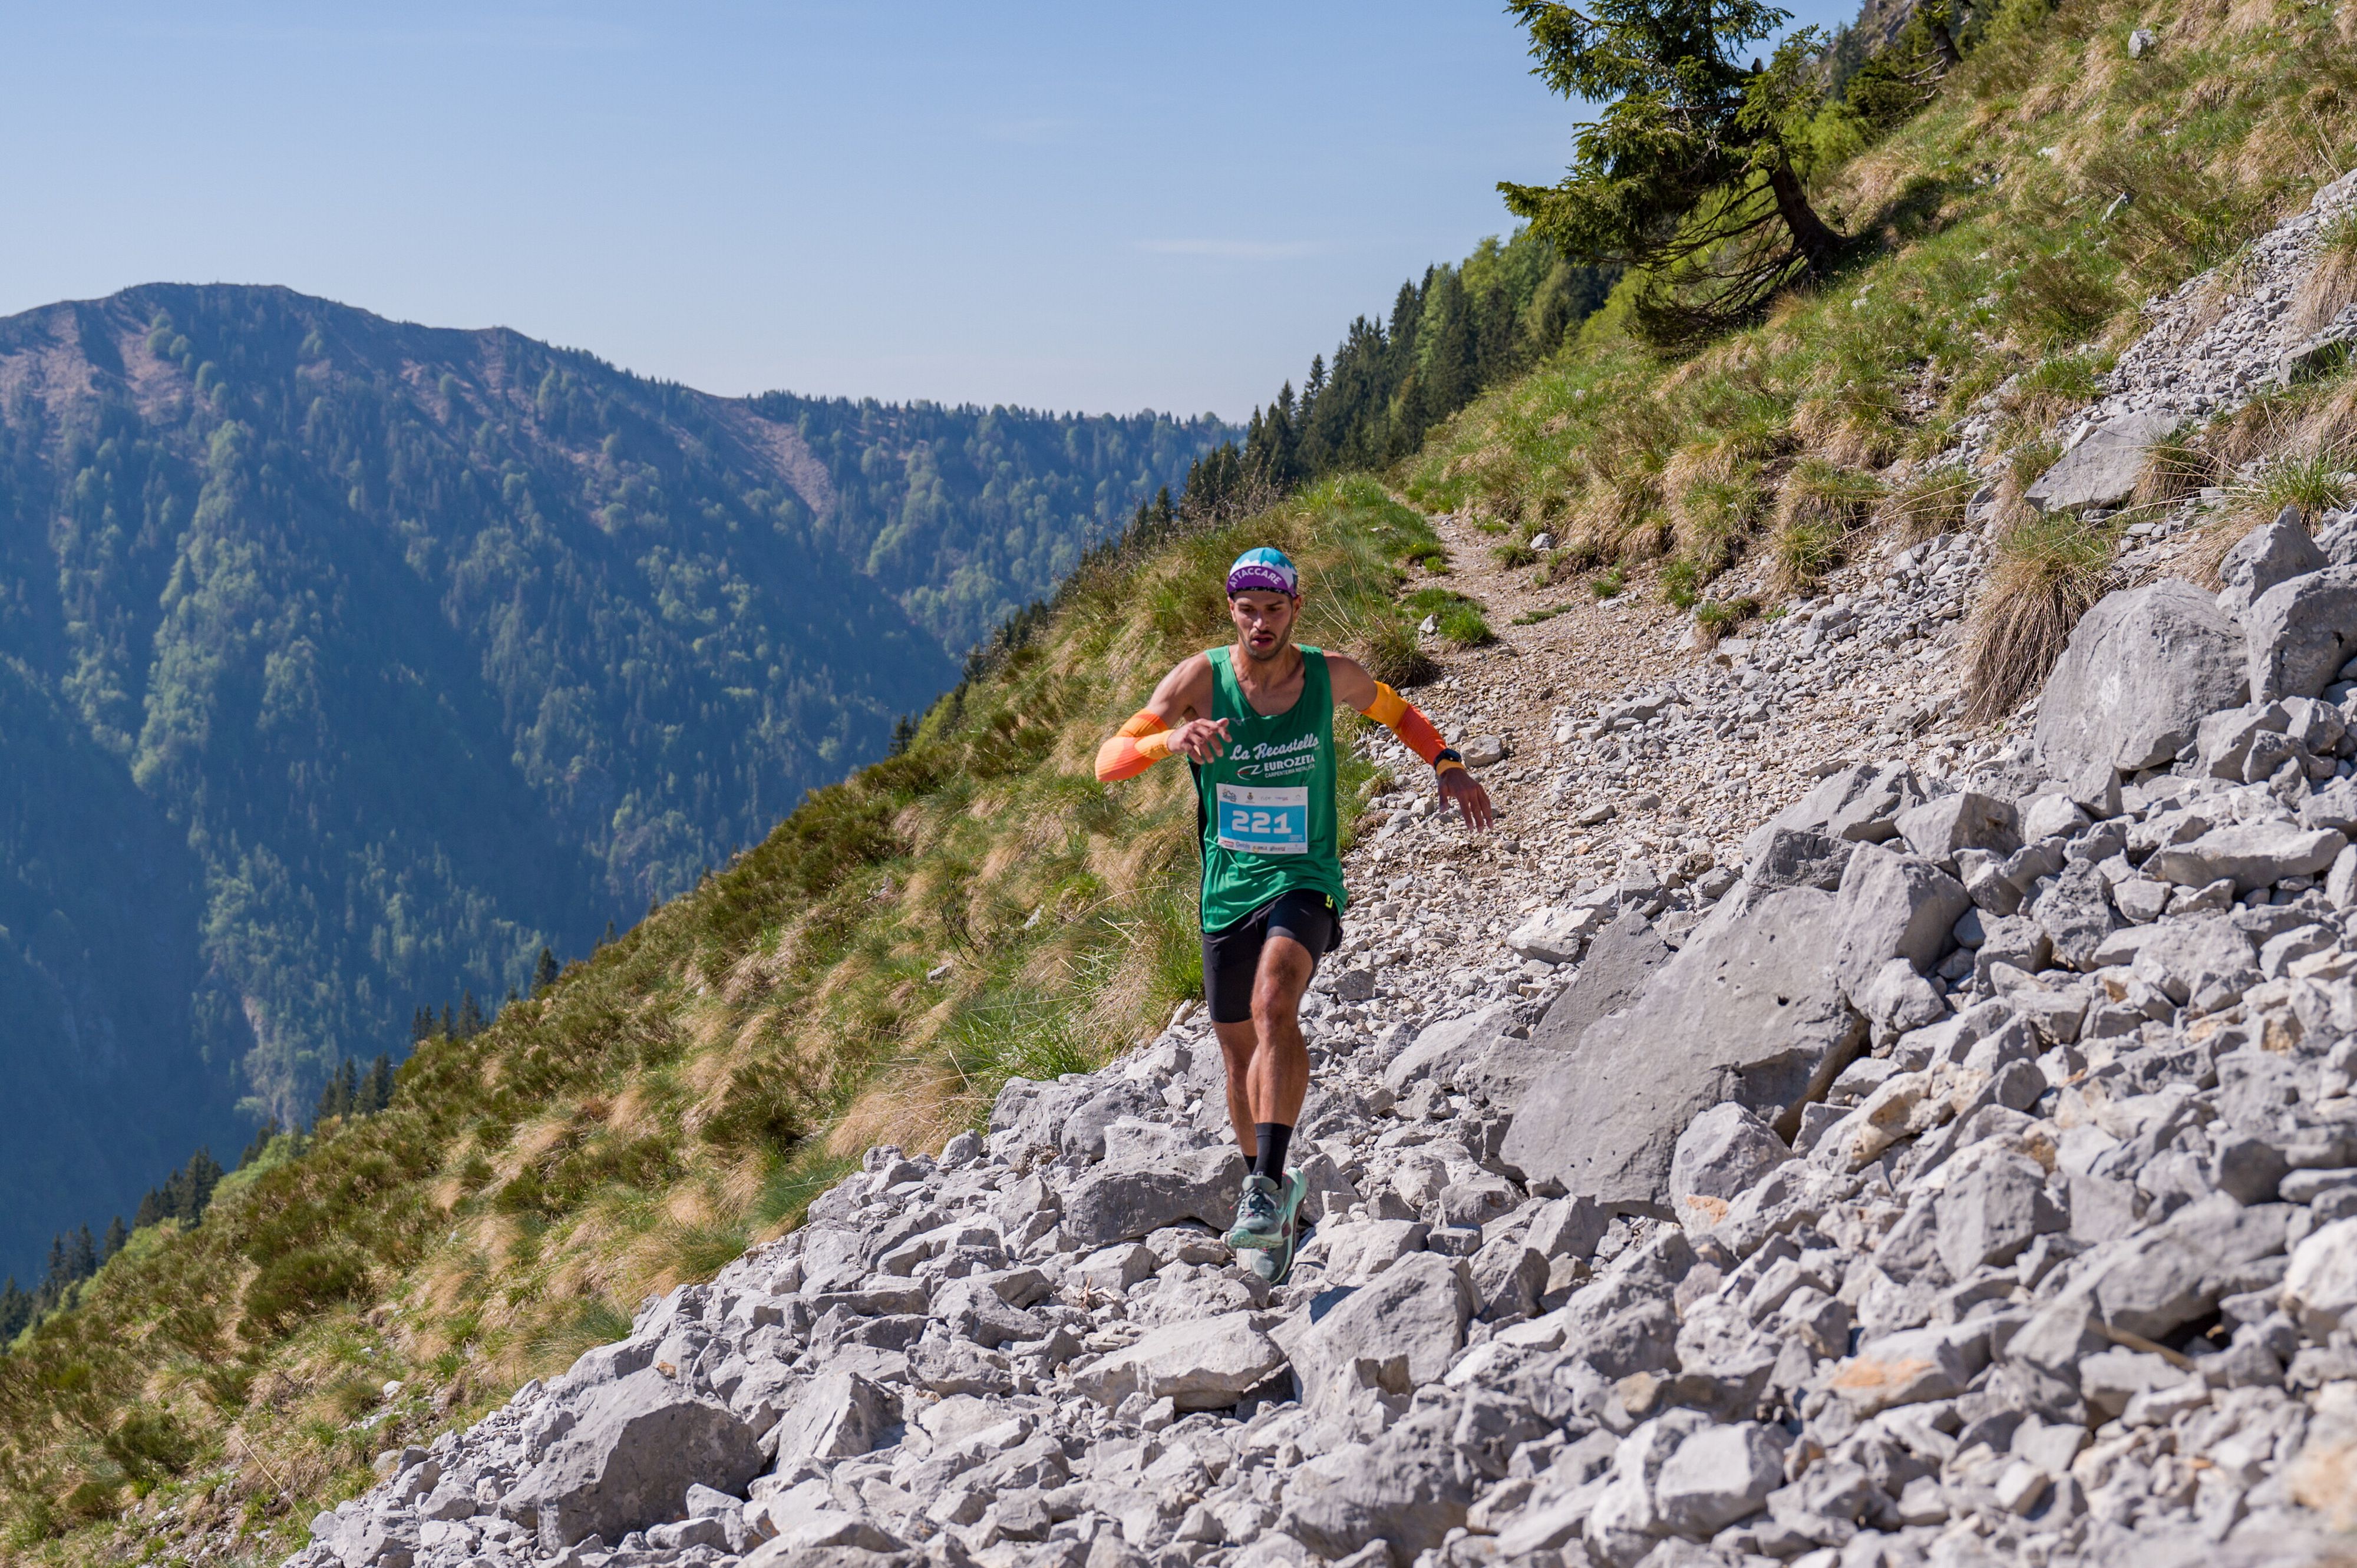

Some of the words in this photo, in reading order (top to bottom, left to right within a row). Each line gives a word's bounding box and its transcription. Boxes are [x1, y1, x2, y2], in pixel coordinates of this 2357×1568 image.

[1229, 567, 1282, 588] ATTACCARE
[1230, 744, 1250, 761] La
[1264, 754, 1315, 771] EUROZETA
[1265, 768, 1295, 778] CARPENTERIA
[1232, 810, 1292, 834] 221
